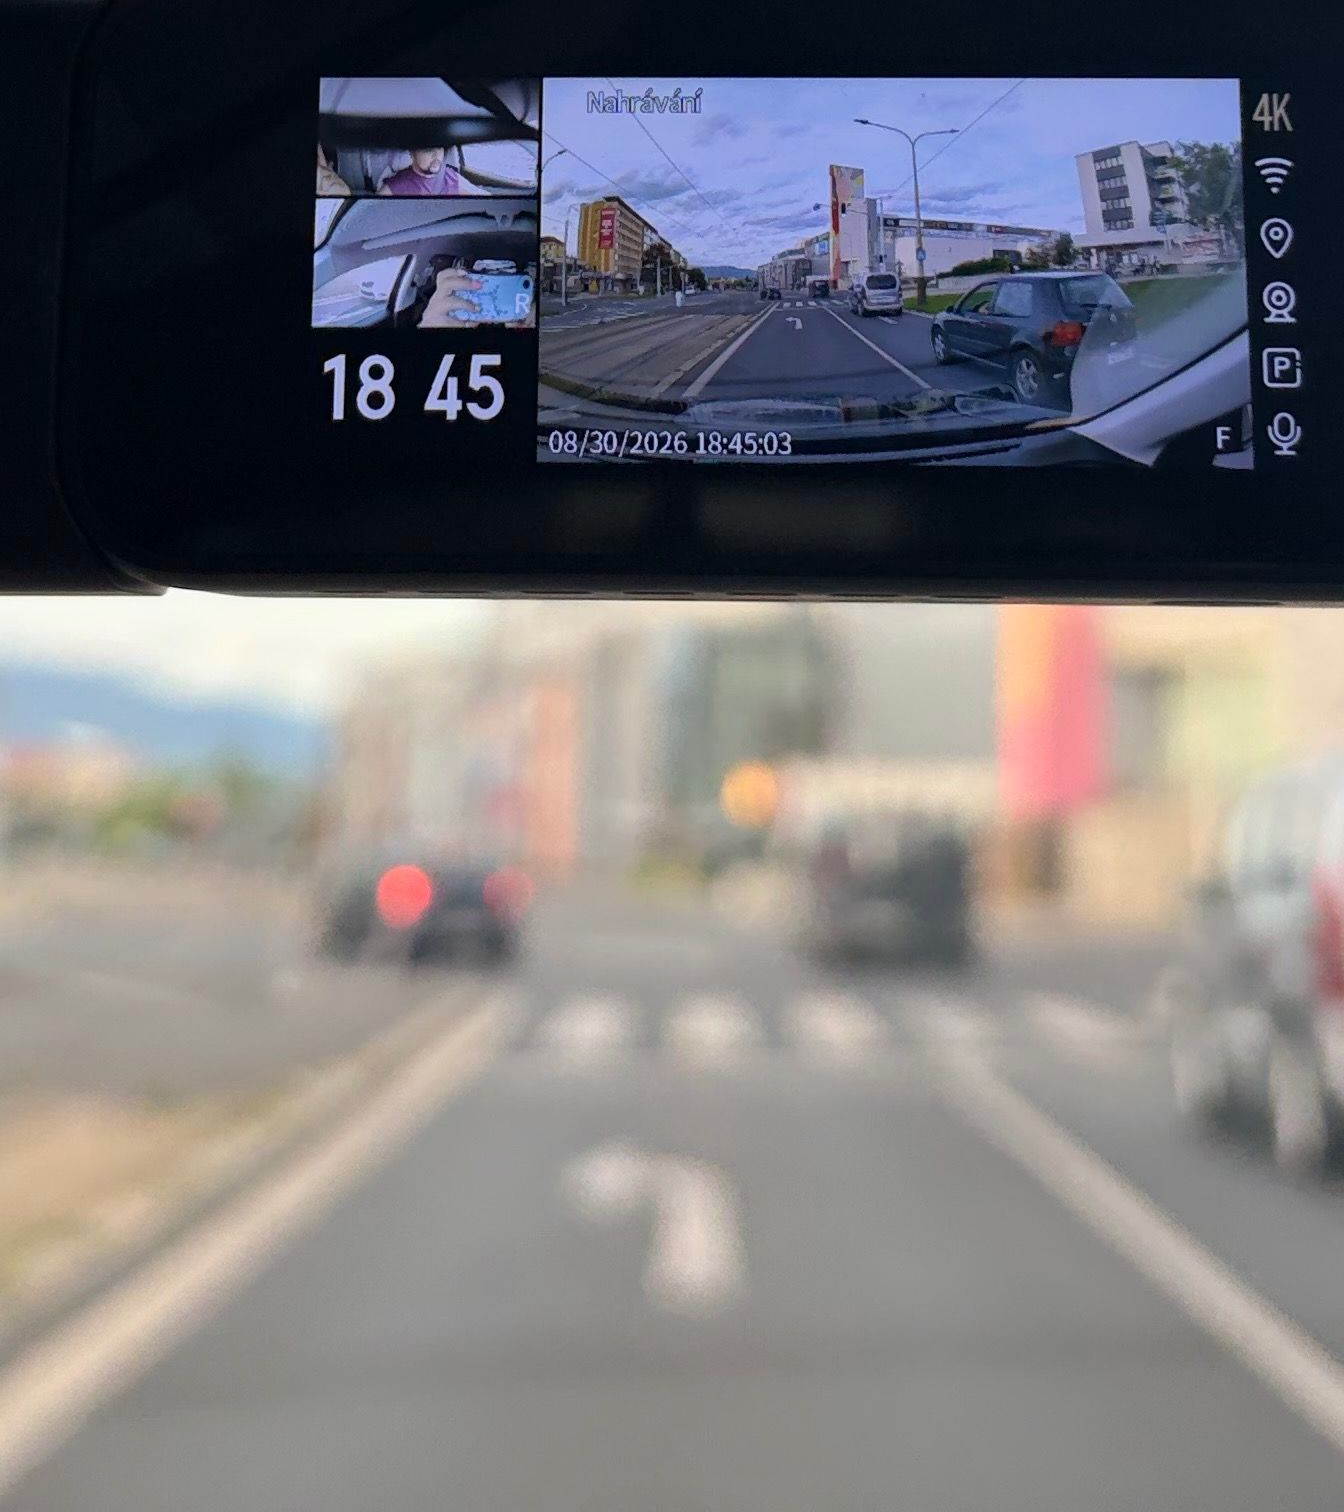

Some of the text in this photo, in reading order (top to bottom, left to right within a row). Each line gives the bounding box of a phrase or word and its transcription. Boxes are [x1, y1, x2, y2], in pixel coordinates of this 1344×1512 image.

[586, 88, 704, 114] Nahrávání
[1252, 93, 1293, 132] 4K
[514, 292, 531, 314] R
[323, 353, 505, 420] 18 45
[548, 429, 793, 458] 08/30/2026 18:45:03
[1216, 426, 1232, 450] F
